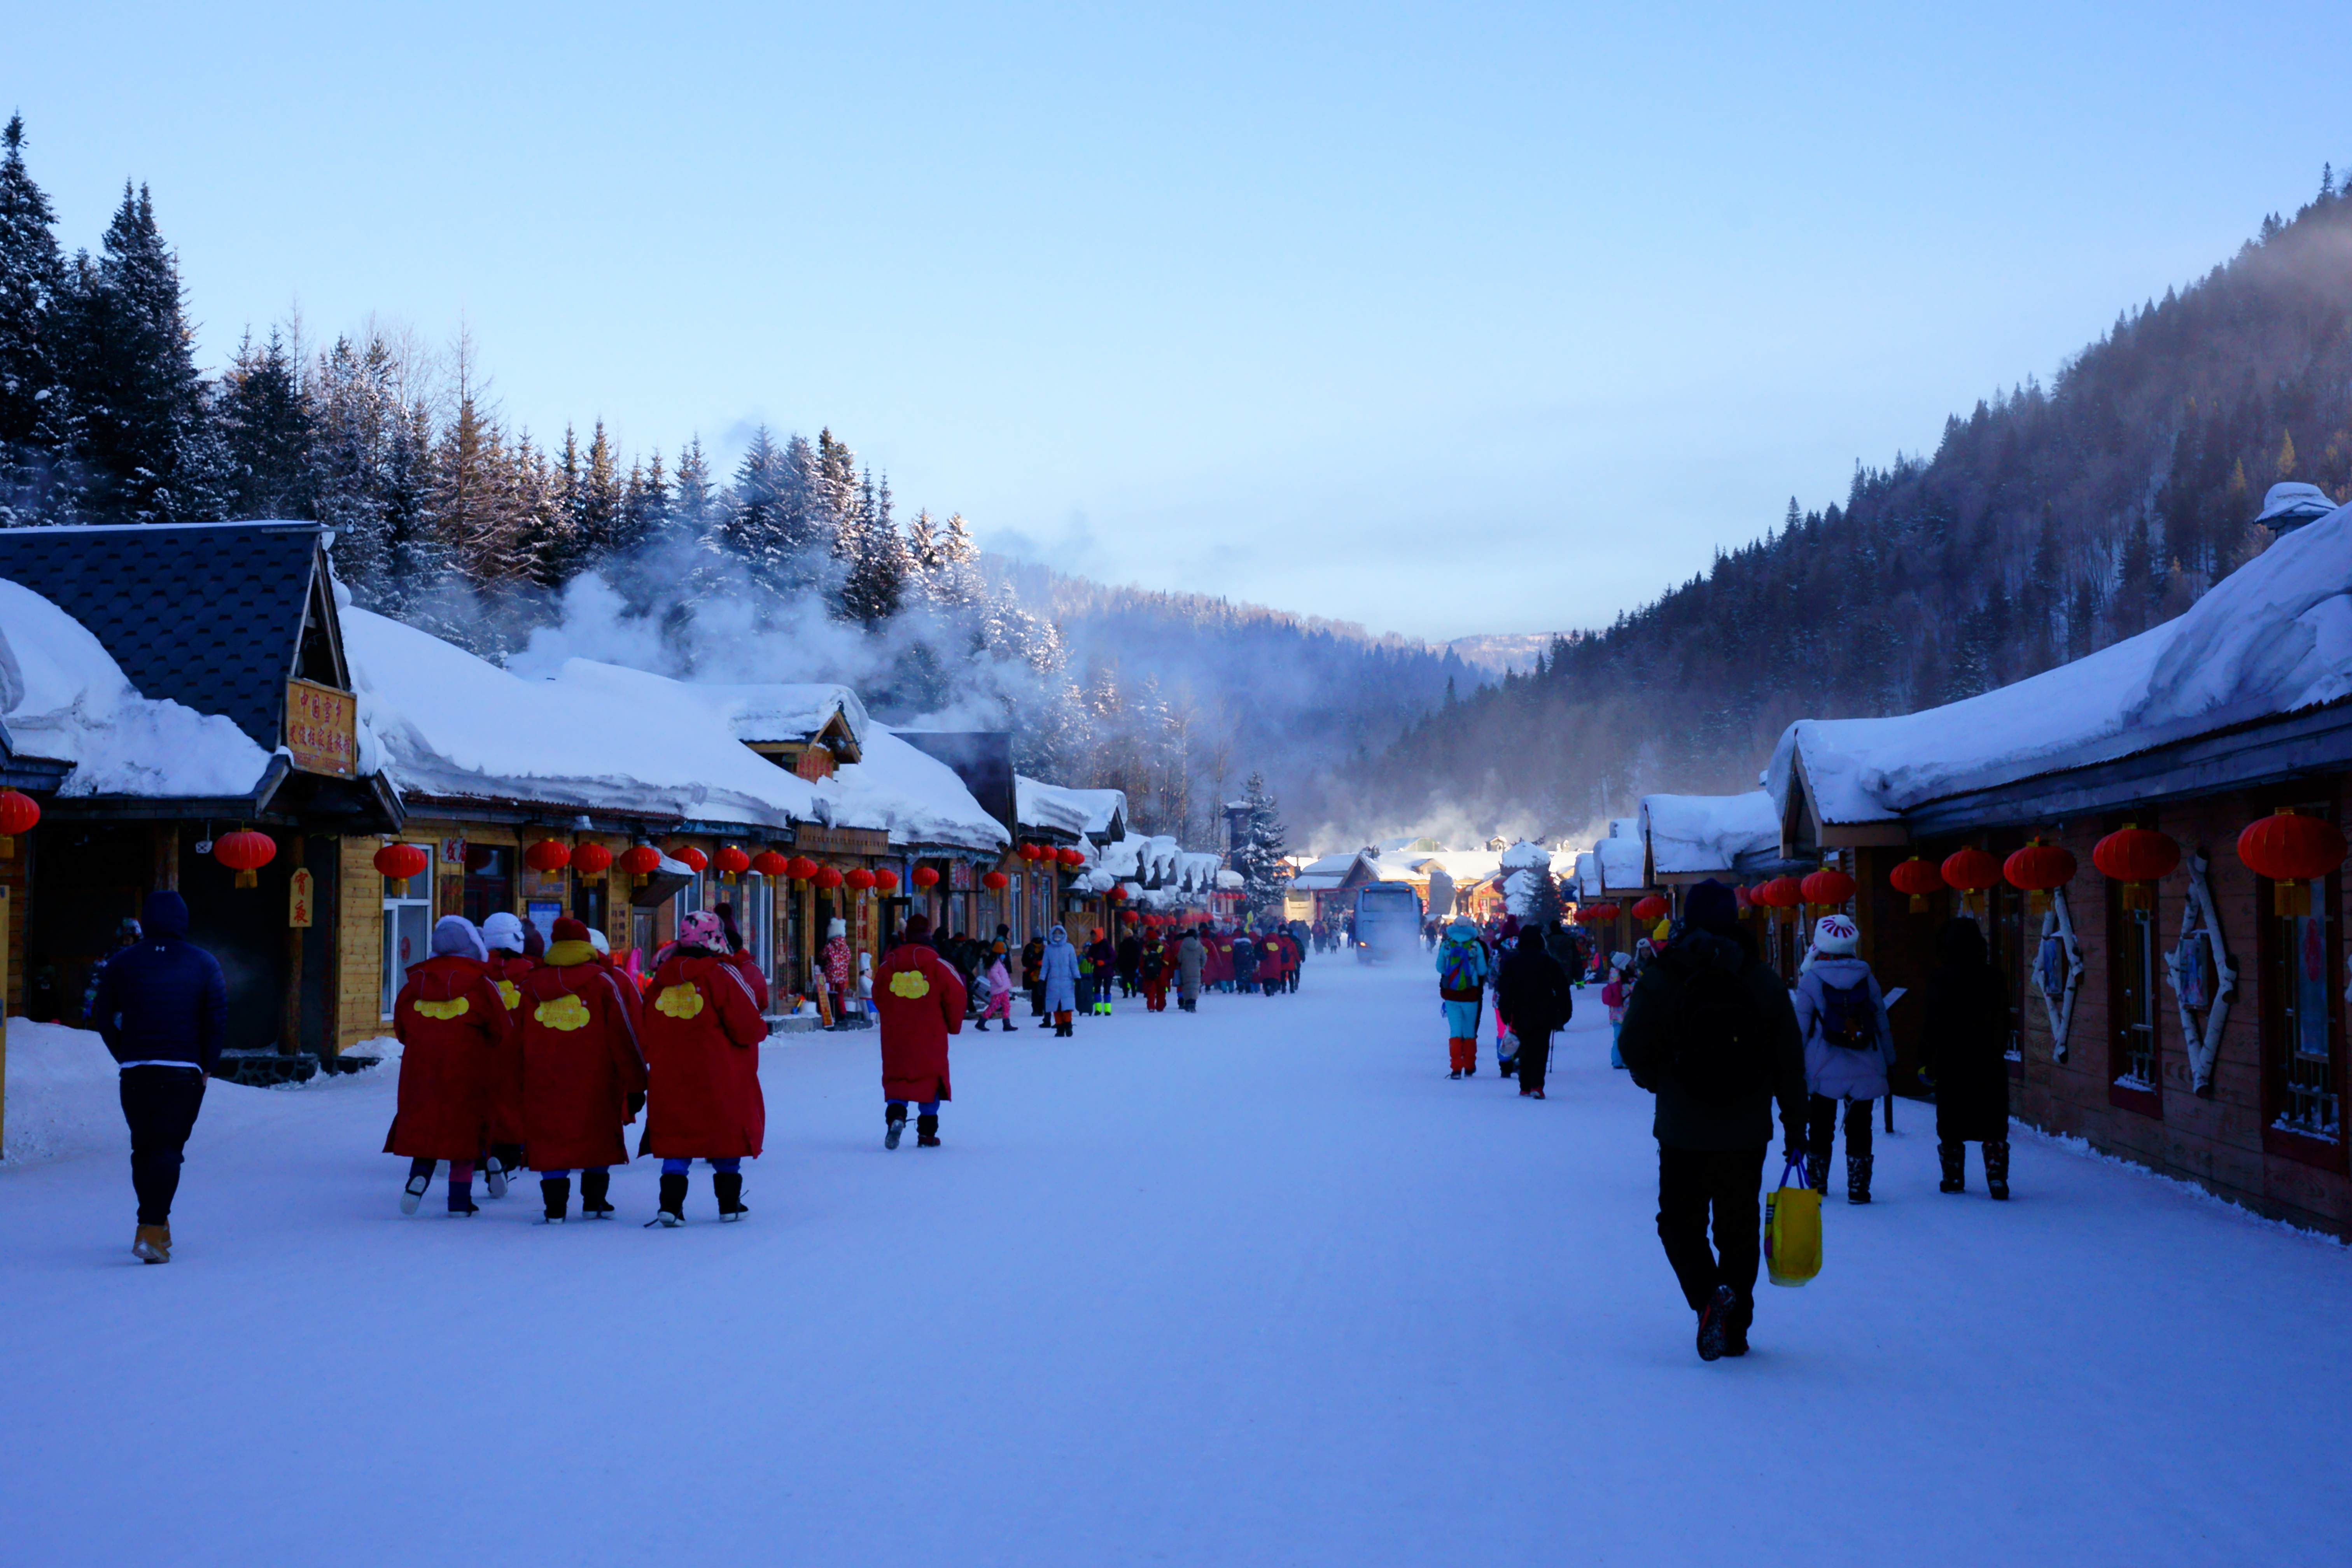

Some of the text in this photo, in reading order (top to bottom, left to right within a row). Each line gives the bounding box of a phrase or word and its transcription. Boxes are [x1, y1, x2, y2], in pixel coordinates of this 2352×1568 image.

[300, 688, 341, 727] 中国雪乡
[294, 871, 308, 924] 宵夜
